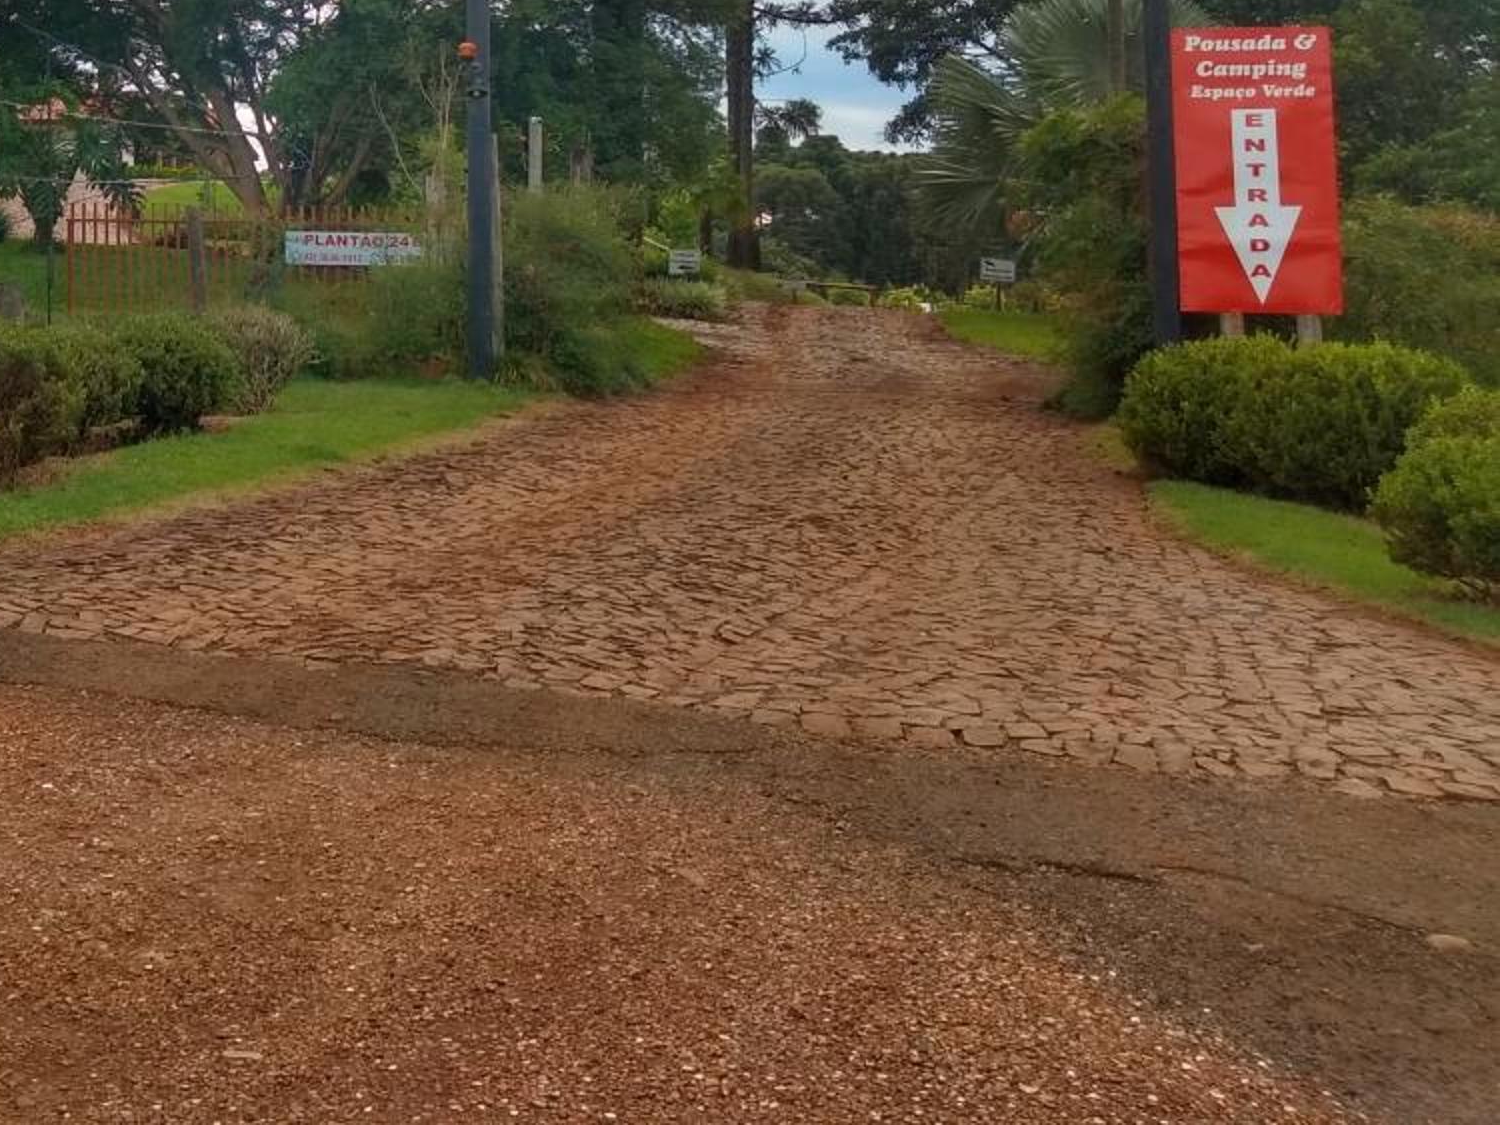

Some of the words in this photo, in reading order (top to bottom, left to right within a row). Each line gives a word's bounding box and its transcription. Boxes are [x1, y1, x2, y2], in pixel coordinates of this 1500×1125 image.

[1184, 35, 1286, 52] Pousada
[1293, 34, 1316, 50] &
[1196, 60, 1307, 79] Camping
[1190, 84, 1256, 99] Espaço
[1262, 84, 1316, 98] Verde
[1244, 113, 1272, 277] ENTRADA
